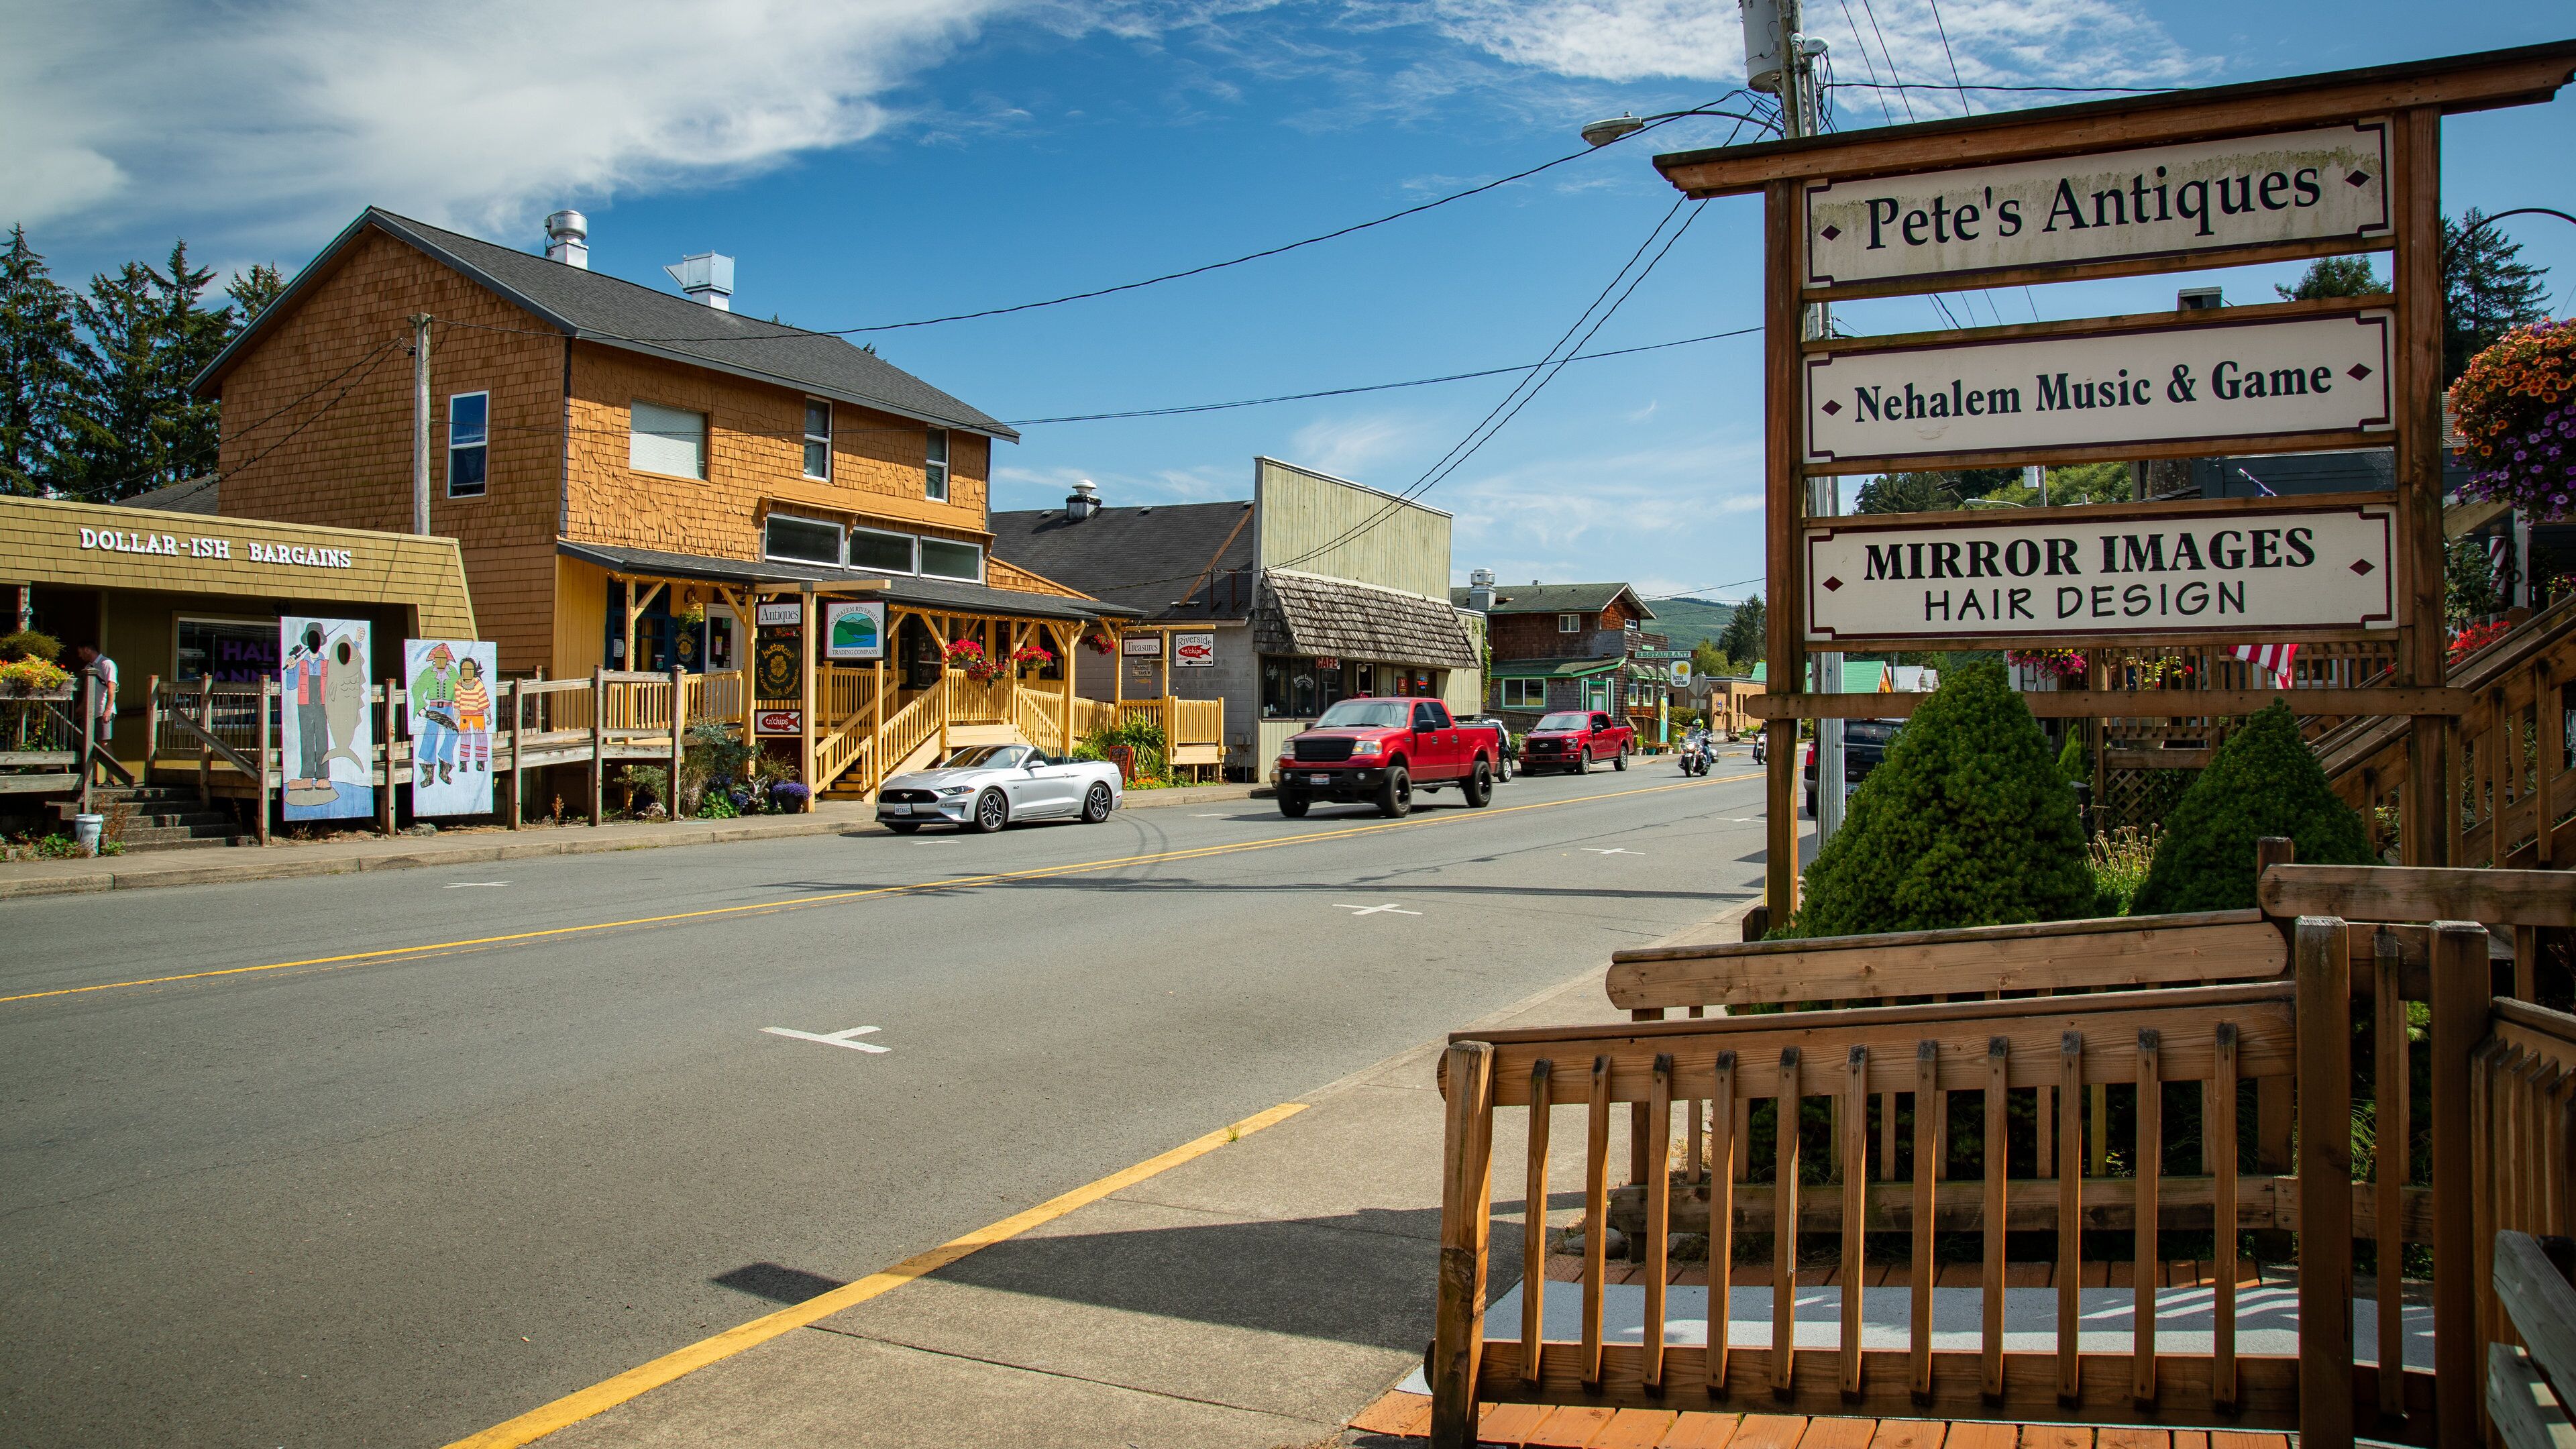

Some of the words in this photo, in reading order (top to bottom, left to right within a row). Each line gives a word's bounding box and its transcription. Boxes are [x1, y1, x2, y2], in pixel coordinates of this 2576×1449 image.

[1864, 186, 2023, 251] Pete's
[2041, 166, 2322, 237] Antiques
[1854, 379, 2022, 423] Nehalem
[2035, 368, 2152, 411] Music
[2167, 364, 2197, 403] &
[2212, 360, 2332, 400] Game
[80, 527, 231, 559] DOLLAR-ISH
[249, 542, 352, 568] BARGAINS
[1864, 538, 2082, 581] MIRROR
[2099, 527, 2316, 574] IMAGES
[1925, 588, 2035, 621] HAIR
[2057, 580, 2245, 619] DESIGN
[761, 606, 799, 623] Antiques
[830, 606, 855, 626] NEHALEM
[855, 606, 881, 626] RIVERSIDE
[761, 643, 795, 659] buttercup
[1126, 641, 1158, 652] Treasures
[1178, 635, 1212, 647] Riverside
[1316, 657, 1337, 668] CAFE
